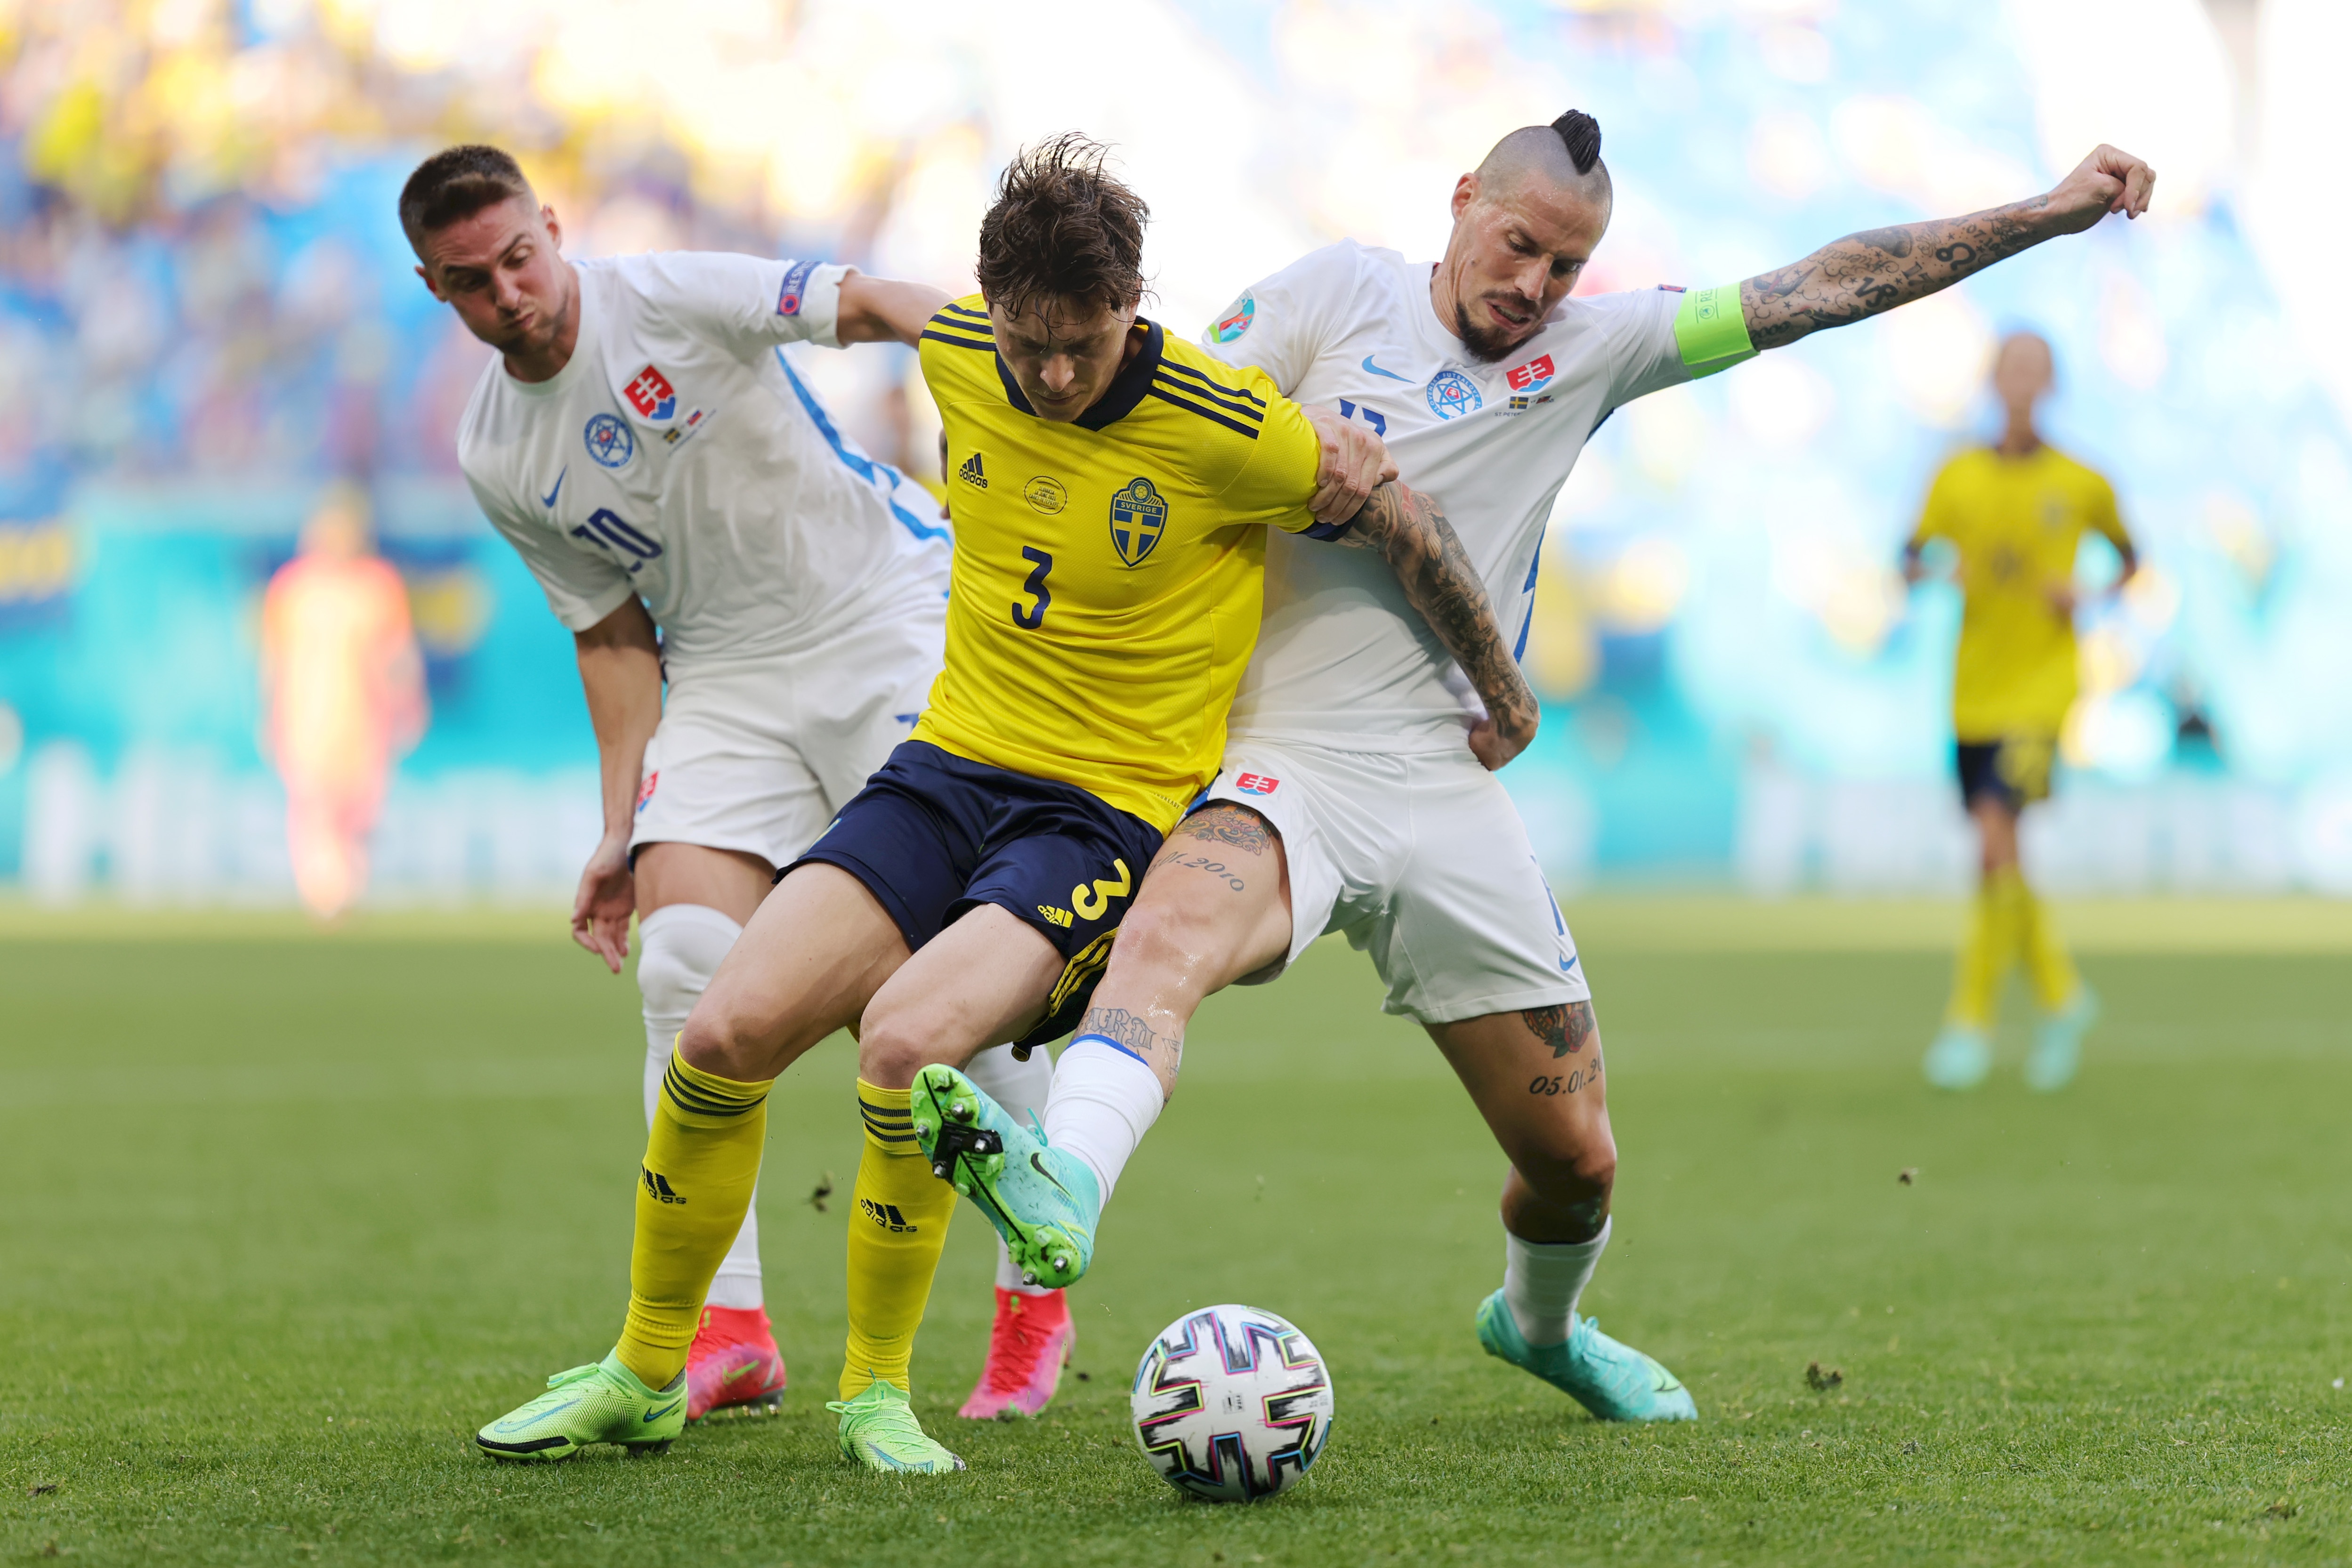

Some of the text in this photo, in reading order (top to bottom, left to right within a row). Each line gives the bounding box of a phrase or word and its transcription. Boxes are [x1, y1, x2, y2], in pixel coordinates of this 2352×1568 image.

[959, 469, 988, 488] adidas
[1121, 502, 1157, 514] SVERIGE
[1011, 545, 1053, 630] 3
[1072, 858, 1131, 921] 3
[861, 1198, 917, 1232] adidas
